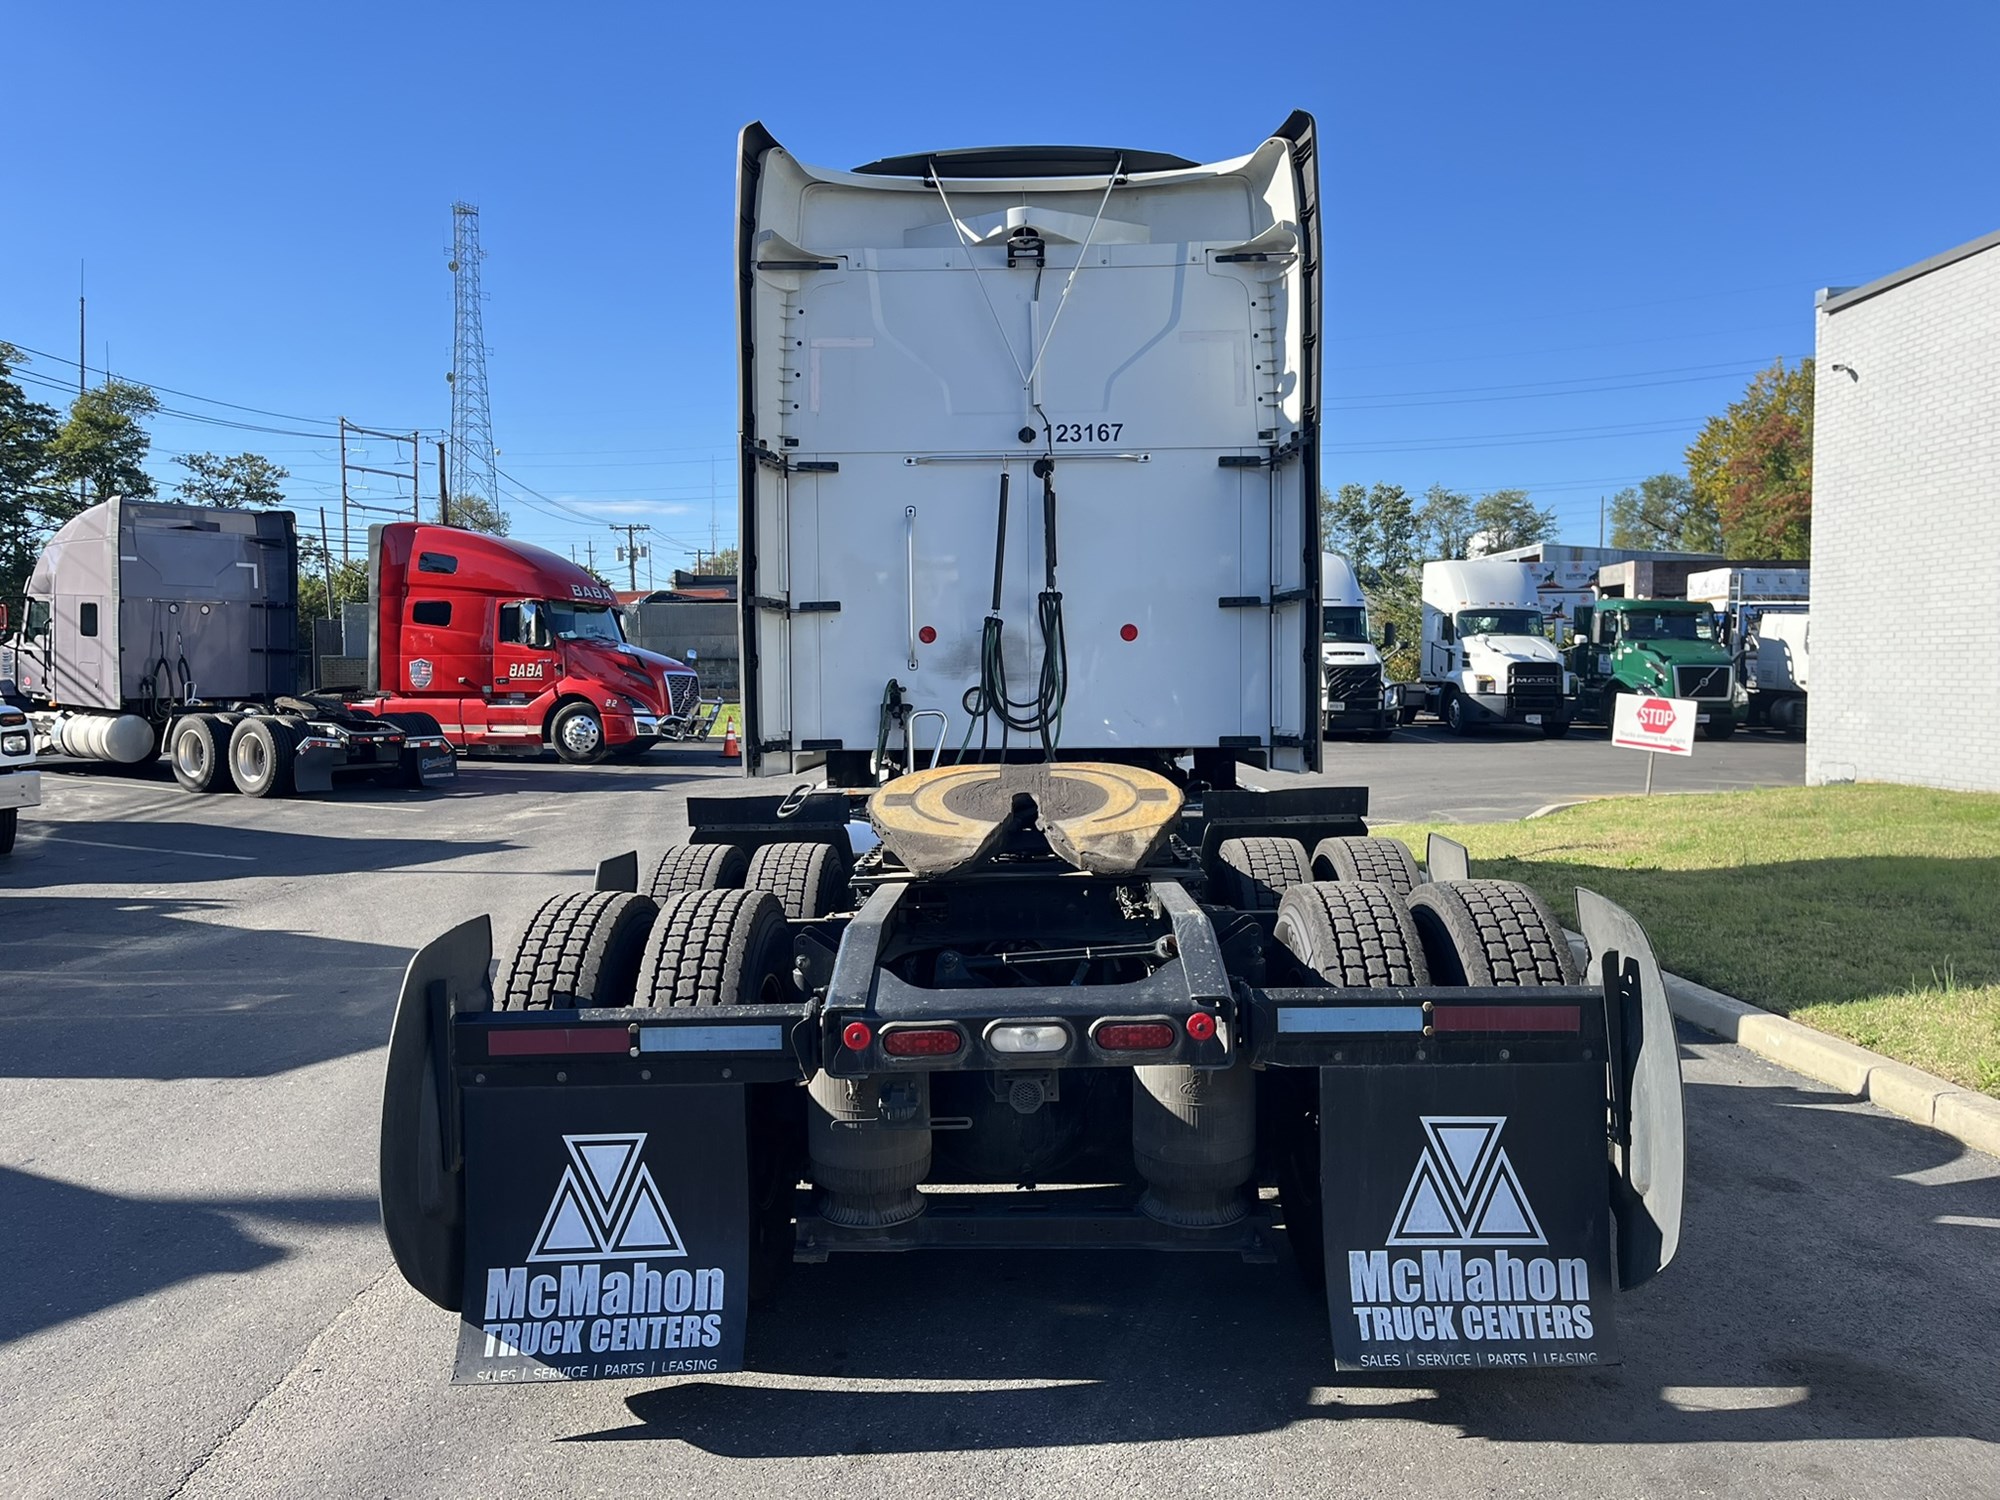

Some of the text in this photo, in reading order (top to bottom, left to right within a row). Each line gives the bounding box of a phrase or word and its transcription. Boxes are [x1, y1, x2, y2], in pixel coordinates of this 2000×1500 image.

[1043, 423, 1123, 443] 123167
[570, 584, 612, 600] BABA
[509, 663, 543, 678] BABA
[605, 698, 617, 707] 22
[1640, 708, 1673, 726] STOP
[1348, 1249, 1590, 1303] McMahon
[484, 1262, 725, 1320] McMahon
[1353, 1304, 1594, 1341] TRUCK CENTERS
[483, 1314, 722, 1357] TRUCK CENTERS
[1360, 1354, 1401, 1367] SALES
[1416, 1353, 1471, 1367] SERVICE
[1487, 1353, 1528, 1366] PARTS
[1543, 1352, 1598, 1365] LEASING
[476, 1369, 517, 1382] SALES
[533, 1365, 588, 1380] SERVICE
[604, 1362, 645, 1376] PARTS
[661, 1359, 718, 1373] LEASING
